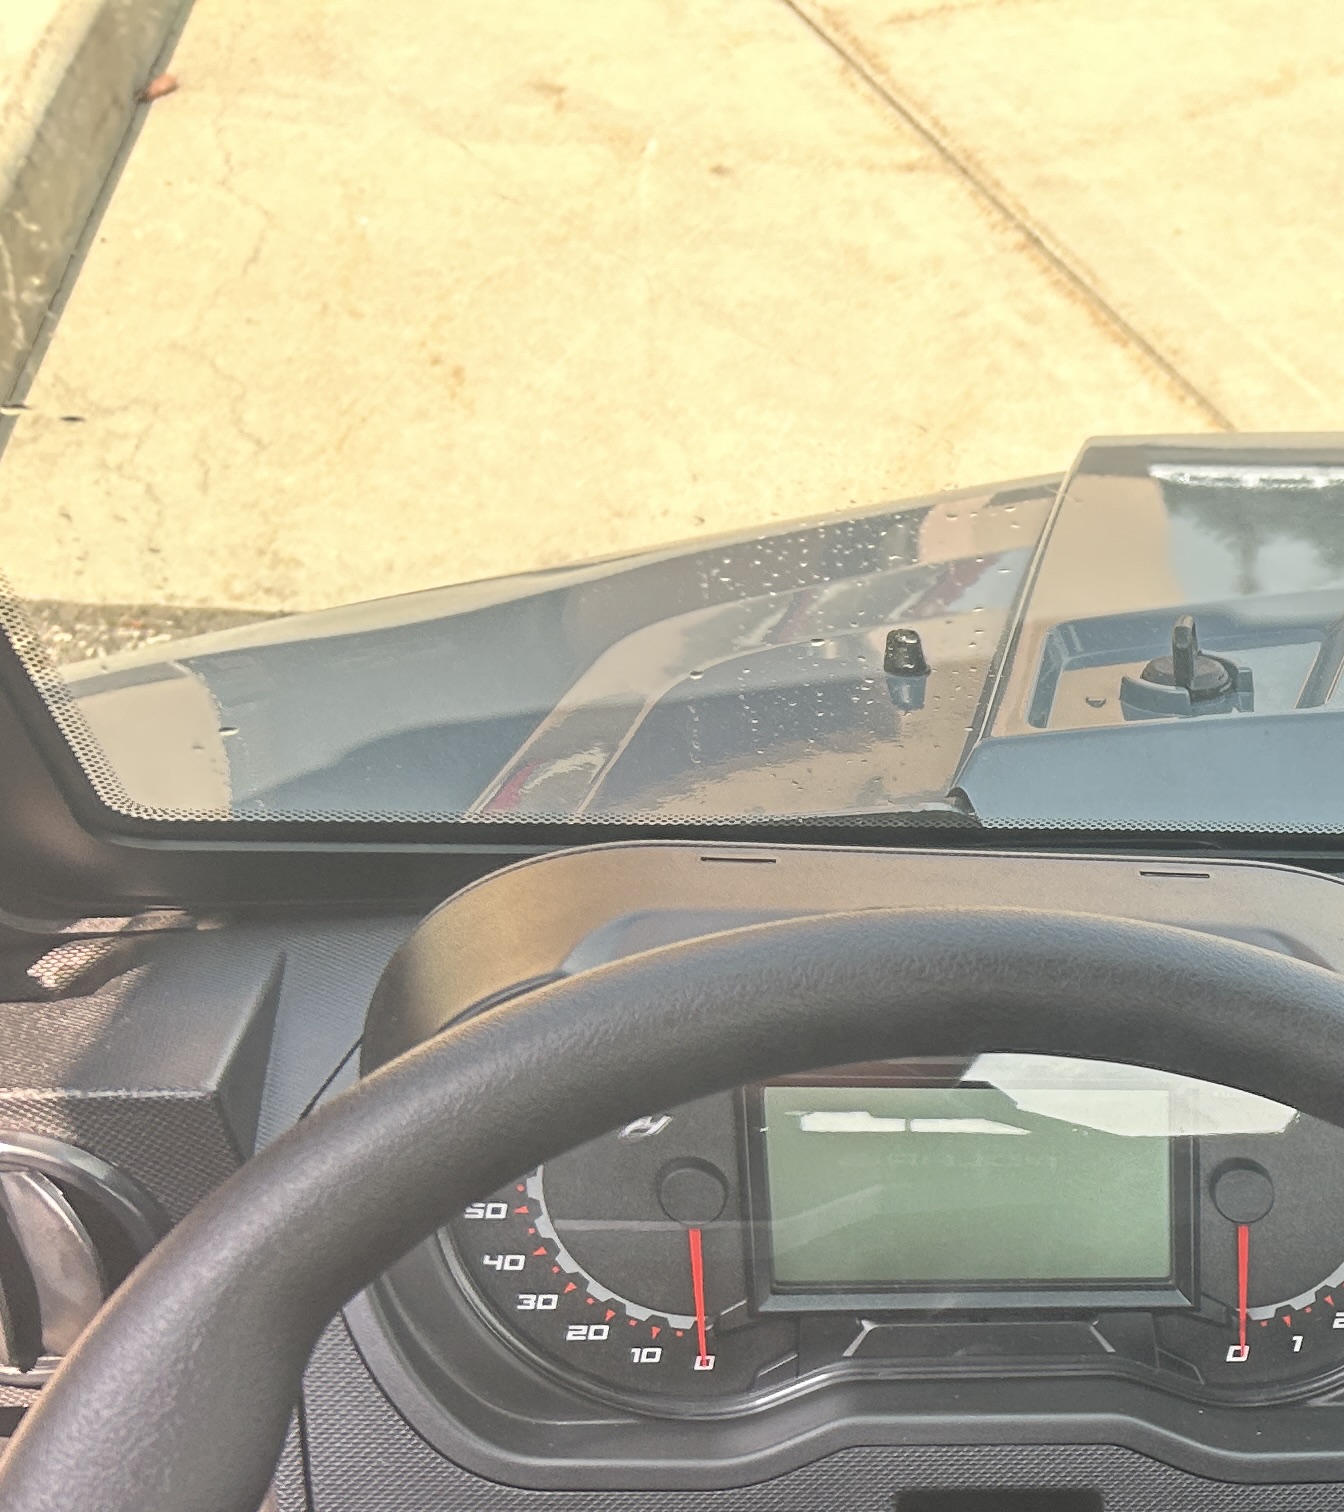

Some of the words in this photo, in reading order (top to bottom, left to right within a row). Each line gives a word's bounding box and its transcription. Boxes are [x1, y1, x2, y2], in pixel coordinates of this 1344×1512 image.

[464, 1203, 508, 1219] 50
[483, 1254, 525, 1271] 40
[517, 1294, 558, 1310] 30
[566, 1325, 609, 1341] 20
[1292, 1335, 1303, 1352] 1
[631, 1347, 662, 1363] 10
[1226, 1345, 1250, 1362] 0
[694, 1355, 715, 1370] 0
